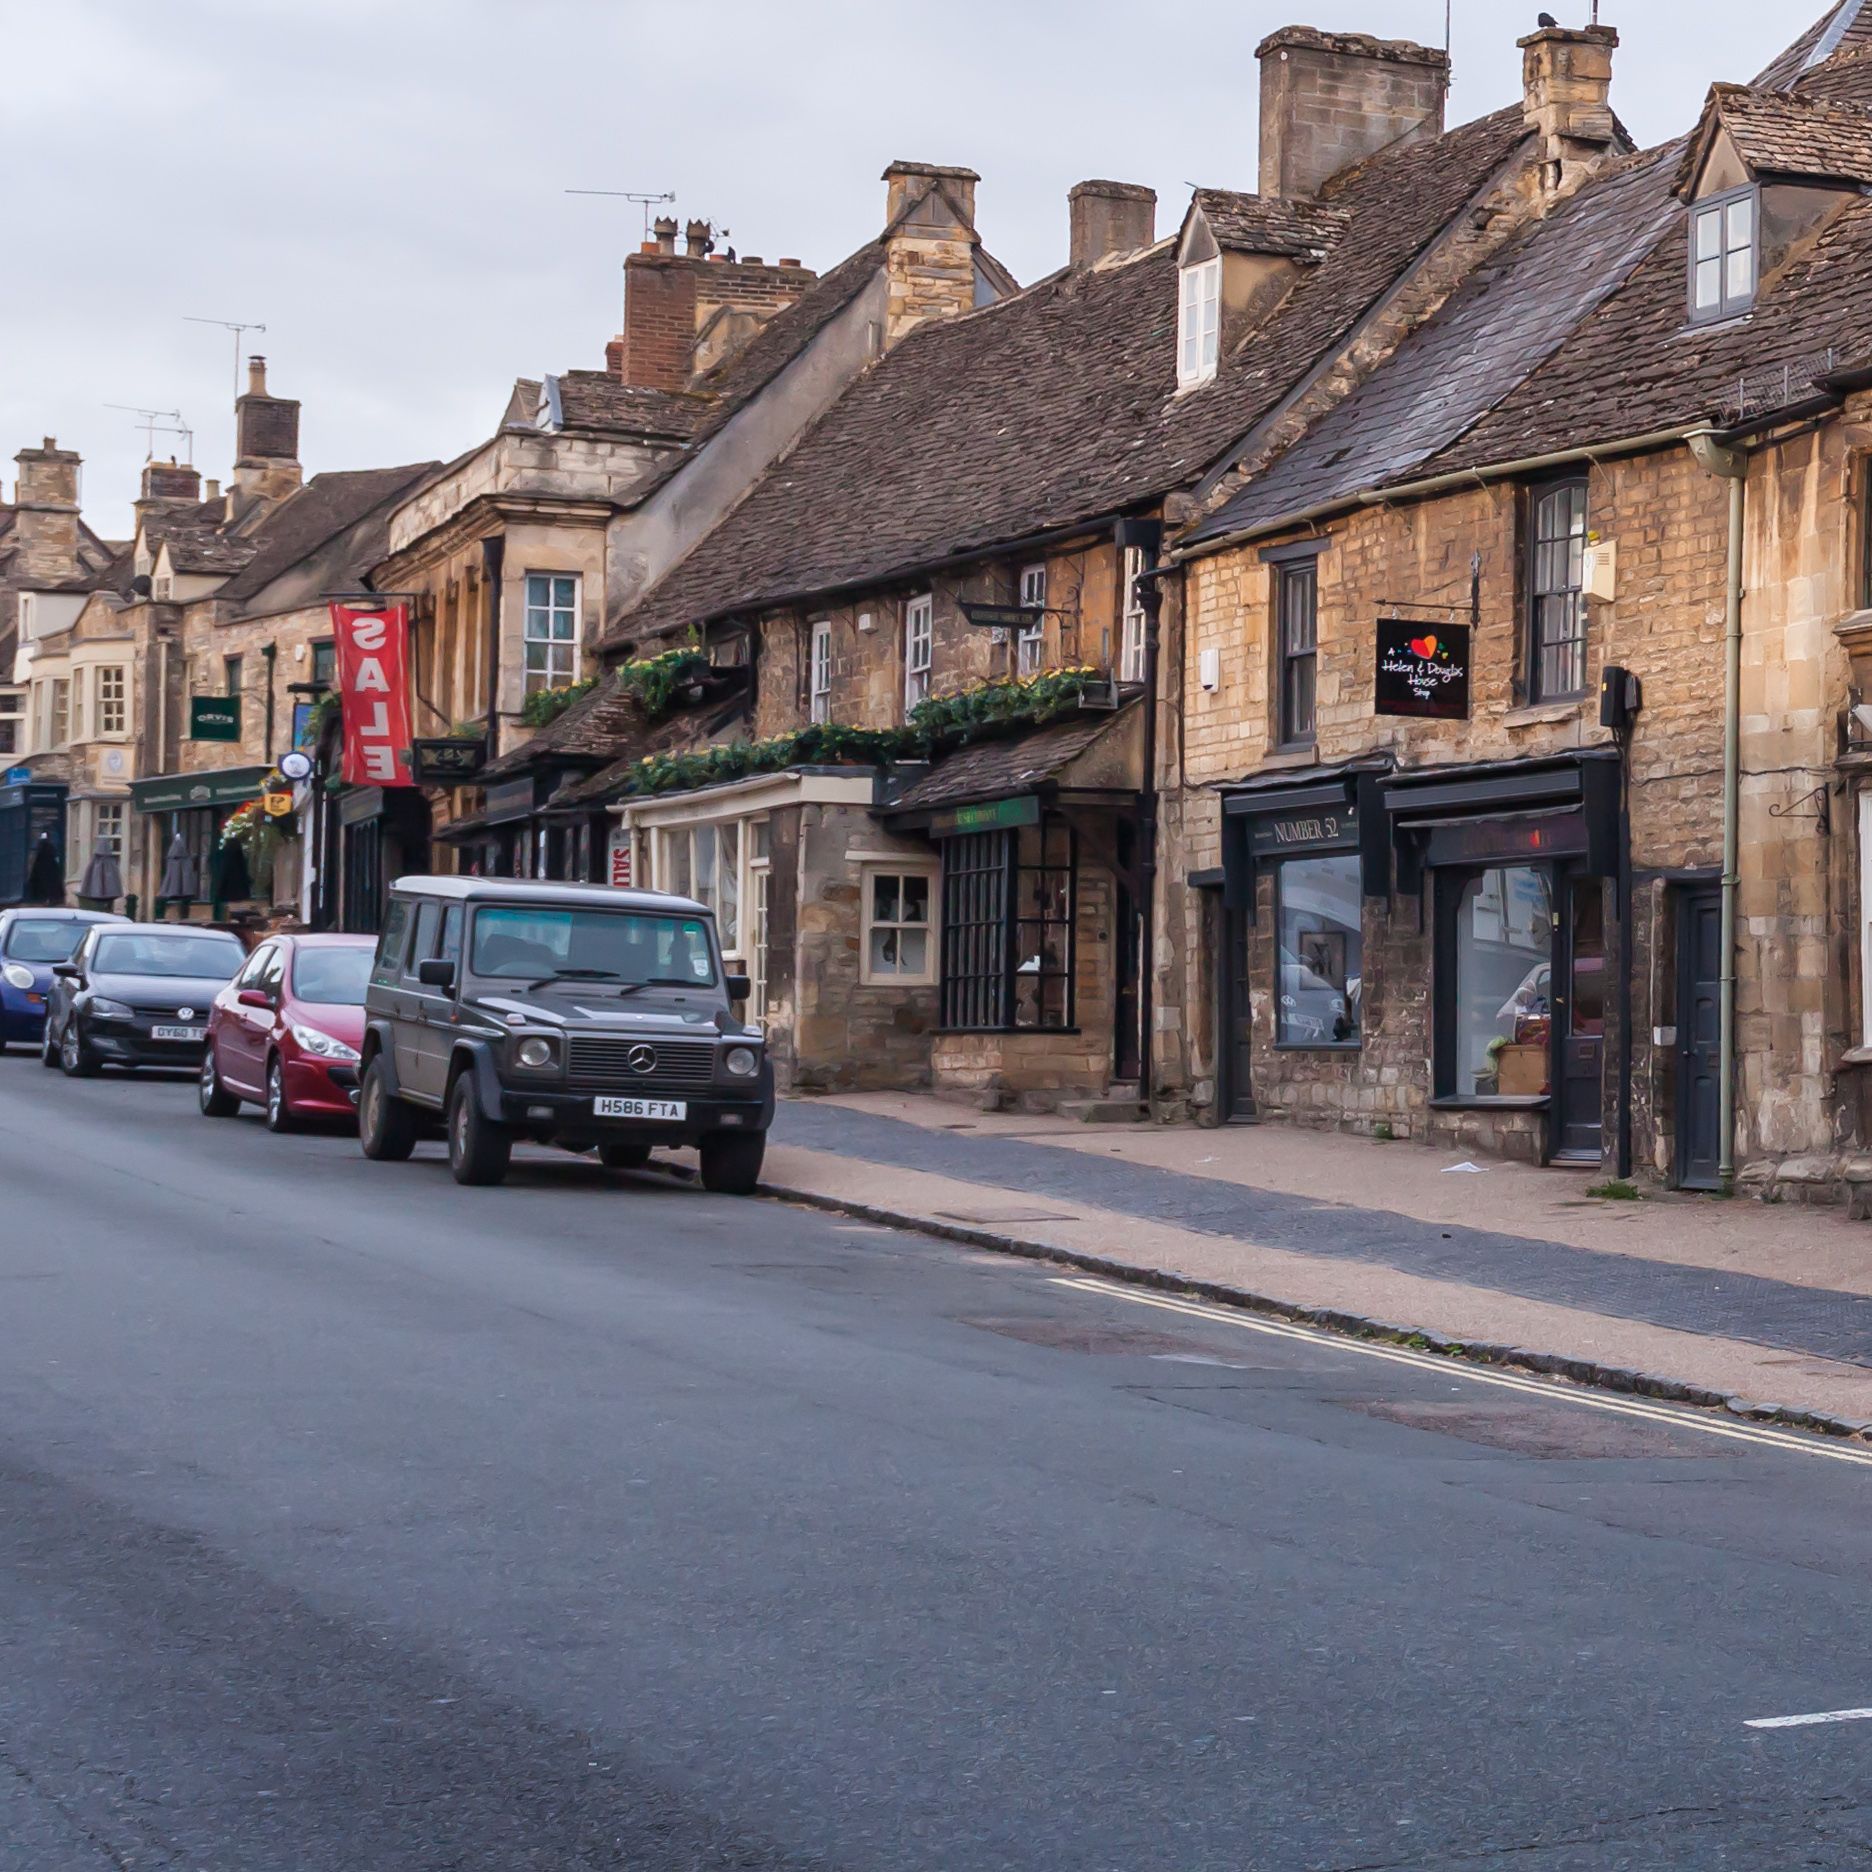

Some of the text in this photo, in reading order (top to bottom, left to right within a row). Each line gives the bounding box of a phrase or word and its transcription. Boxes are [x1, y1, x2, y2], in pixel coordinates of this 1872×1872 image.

[1381, 659, 1414, 673] Helen
[1427, 662, 1464, 683] Douglas
[1407, 674, 1439, 687] House
[1274, 817, 1339, 843] NUMBER 52
[612, 848, 630, 887] SAL
[601, 1099, 679, 1117] H586 FTA
